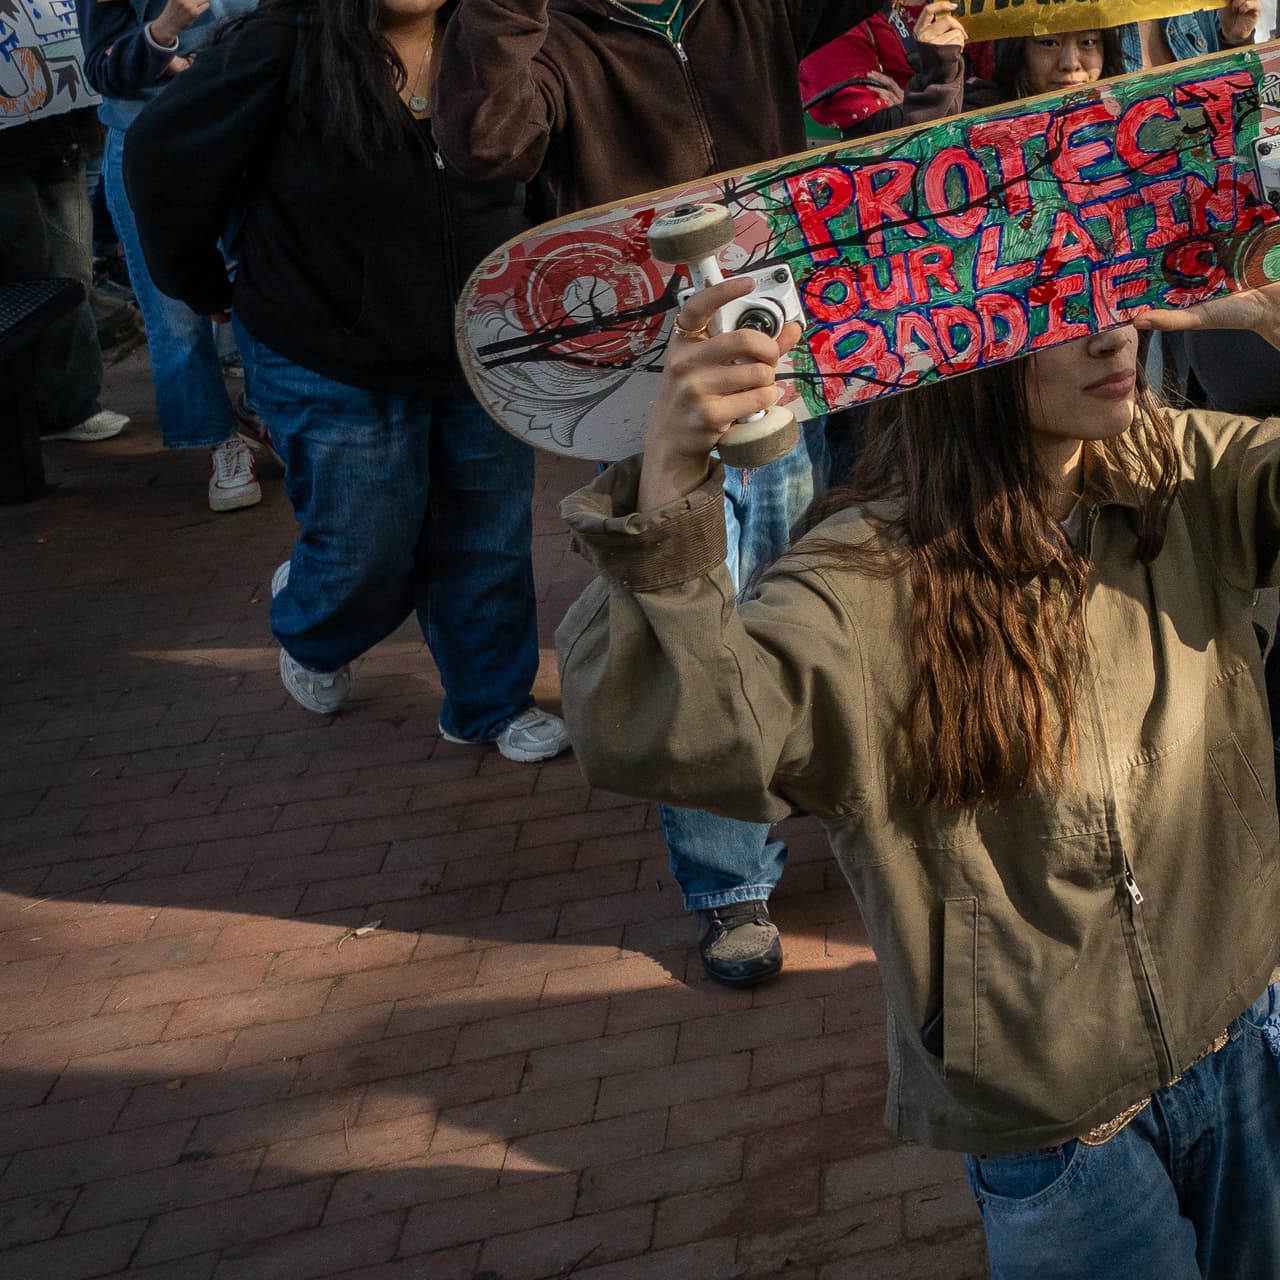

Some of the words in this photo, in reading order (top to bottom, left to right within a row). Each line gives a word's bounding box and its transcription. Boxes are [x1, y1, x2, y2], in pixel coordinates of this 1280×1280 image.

[786, 70, 1260, 262] PROTECT
[804, 242, 960, 323] OUR
[974, 161, 1280, 292] LATINA
[806, 238, 1229, 410] BADDIES
